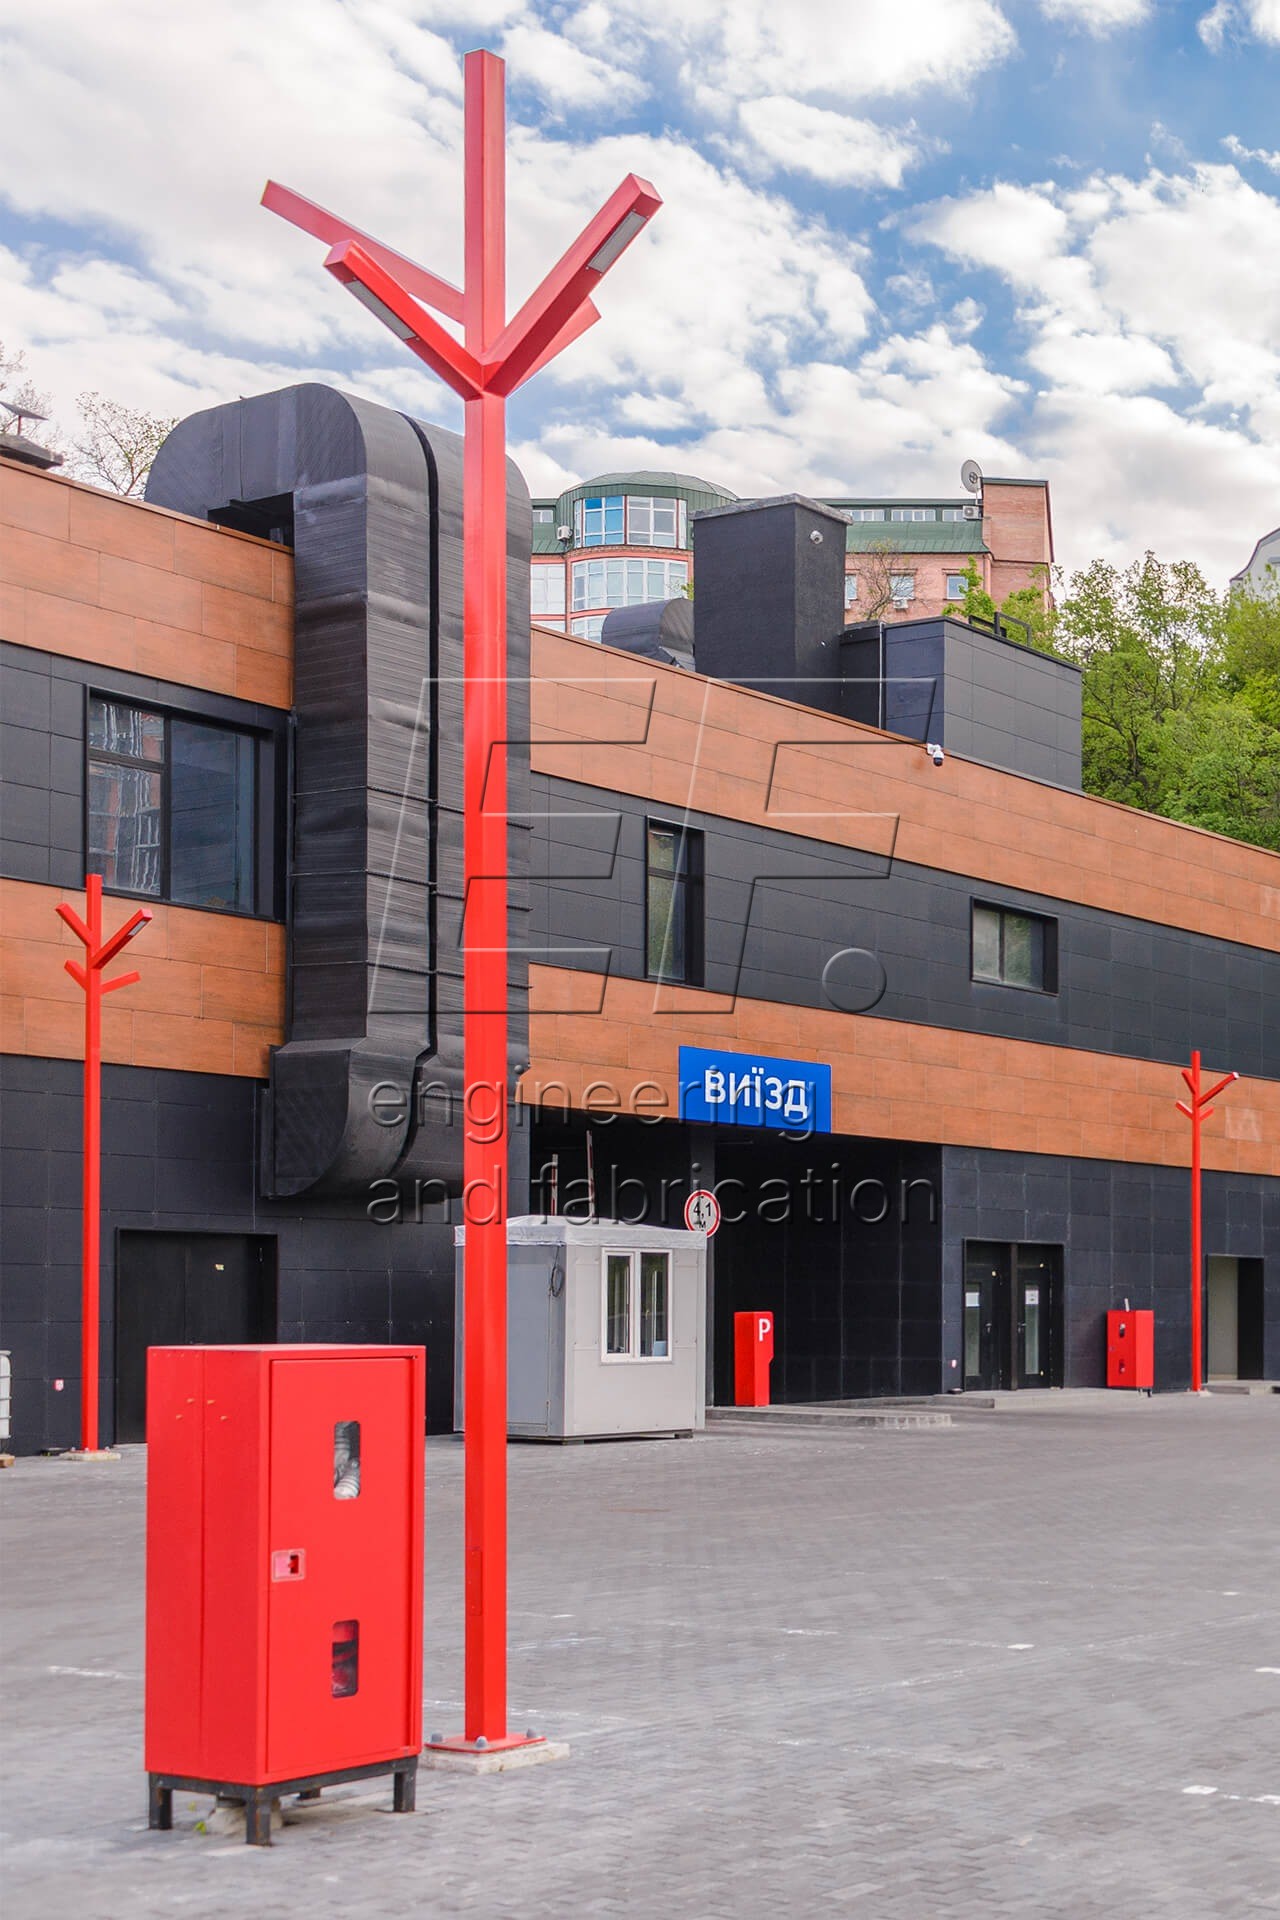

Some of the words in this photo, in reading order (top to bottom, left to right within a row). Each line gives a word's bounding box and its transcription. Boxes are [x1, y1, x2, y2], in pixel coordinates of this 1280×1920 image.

[705, 1067, 808, 1120] ВИЇЗД
[693, 1201, 712, 1219] 4,1
[758, 1318, 771, 1342] P
